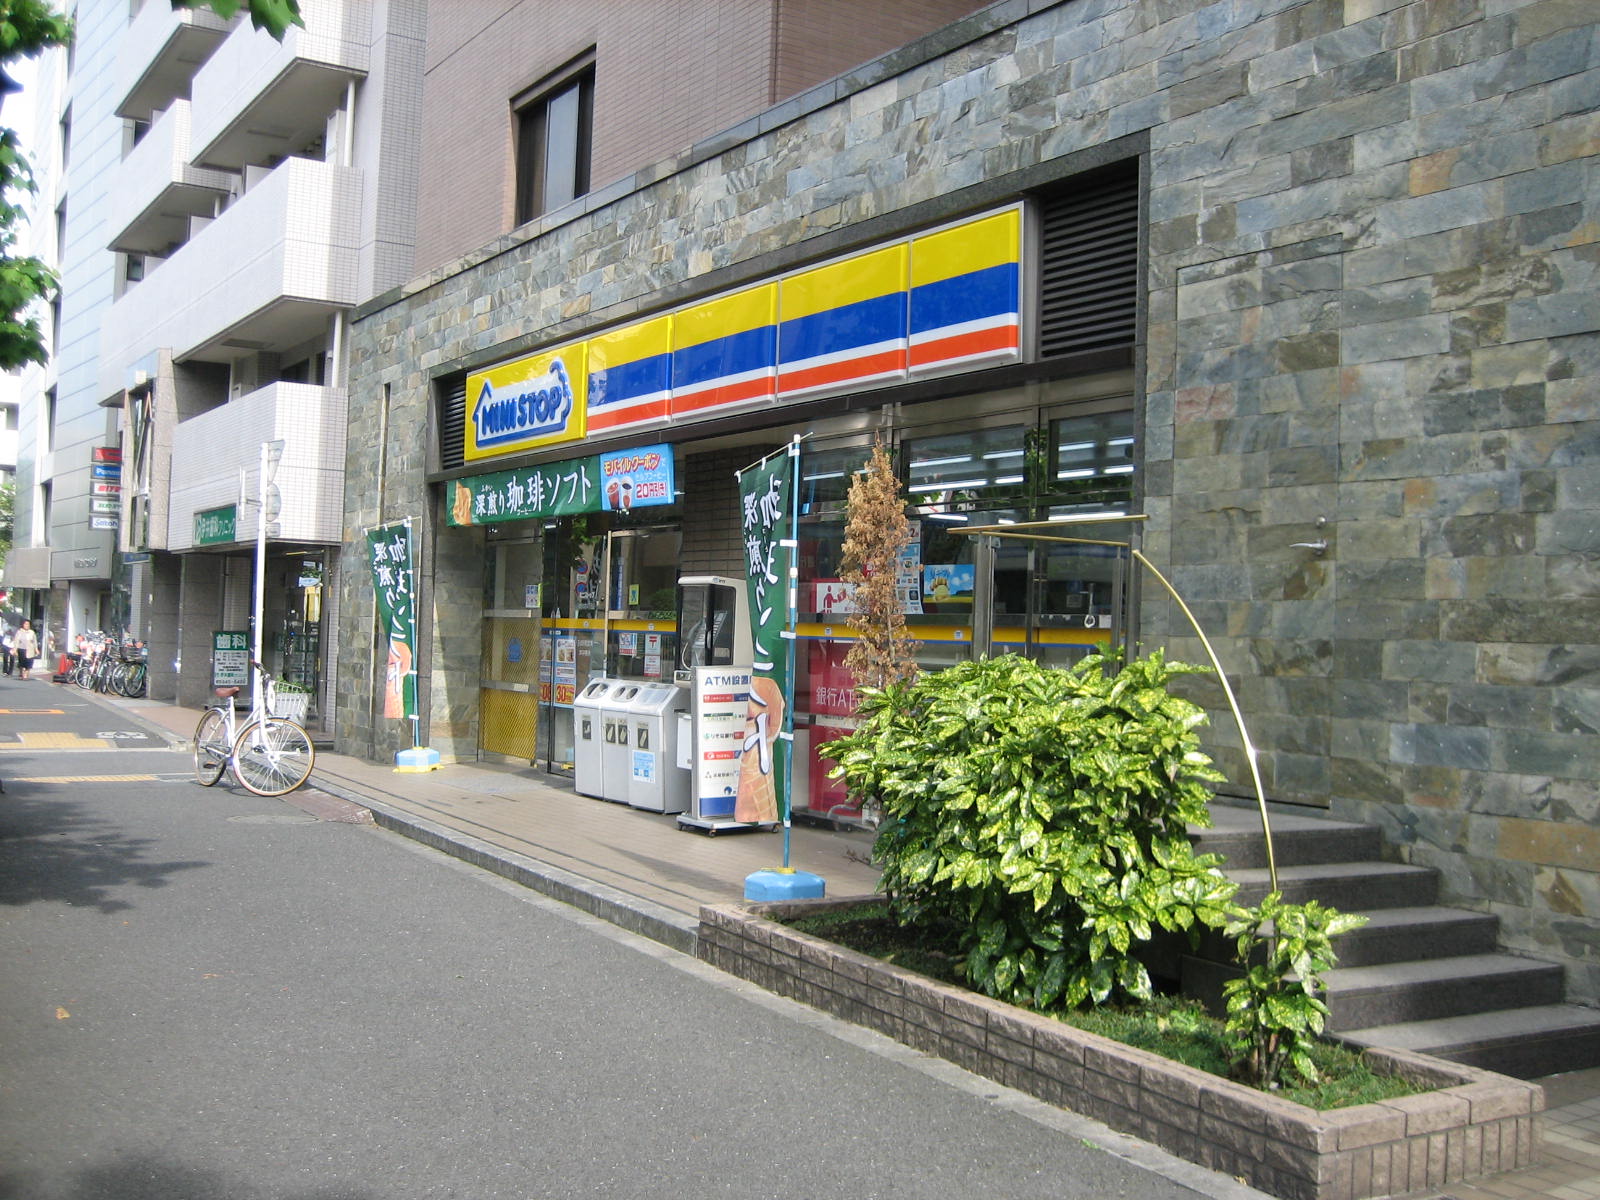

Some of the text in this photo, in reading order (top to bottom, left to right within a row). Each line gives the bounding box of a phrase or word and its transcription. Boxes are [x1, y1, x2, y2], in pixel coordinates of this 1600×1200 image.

[482, 386, 562, 435] MINISTOP
[216, 634, 246, 648] 歯科
[705, 675, 751, 686] ATM設置
